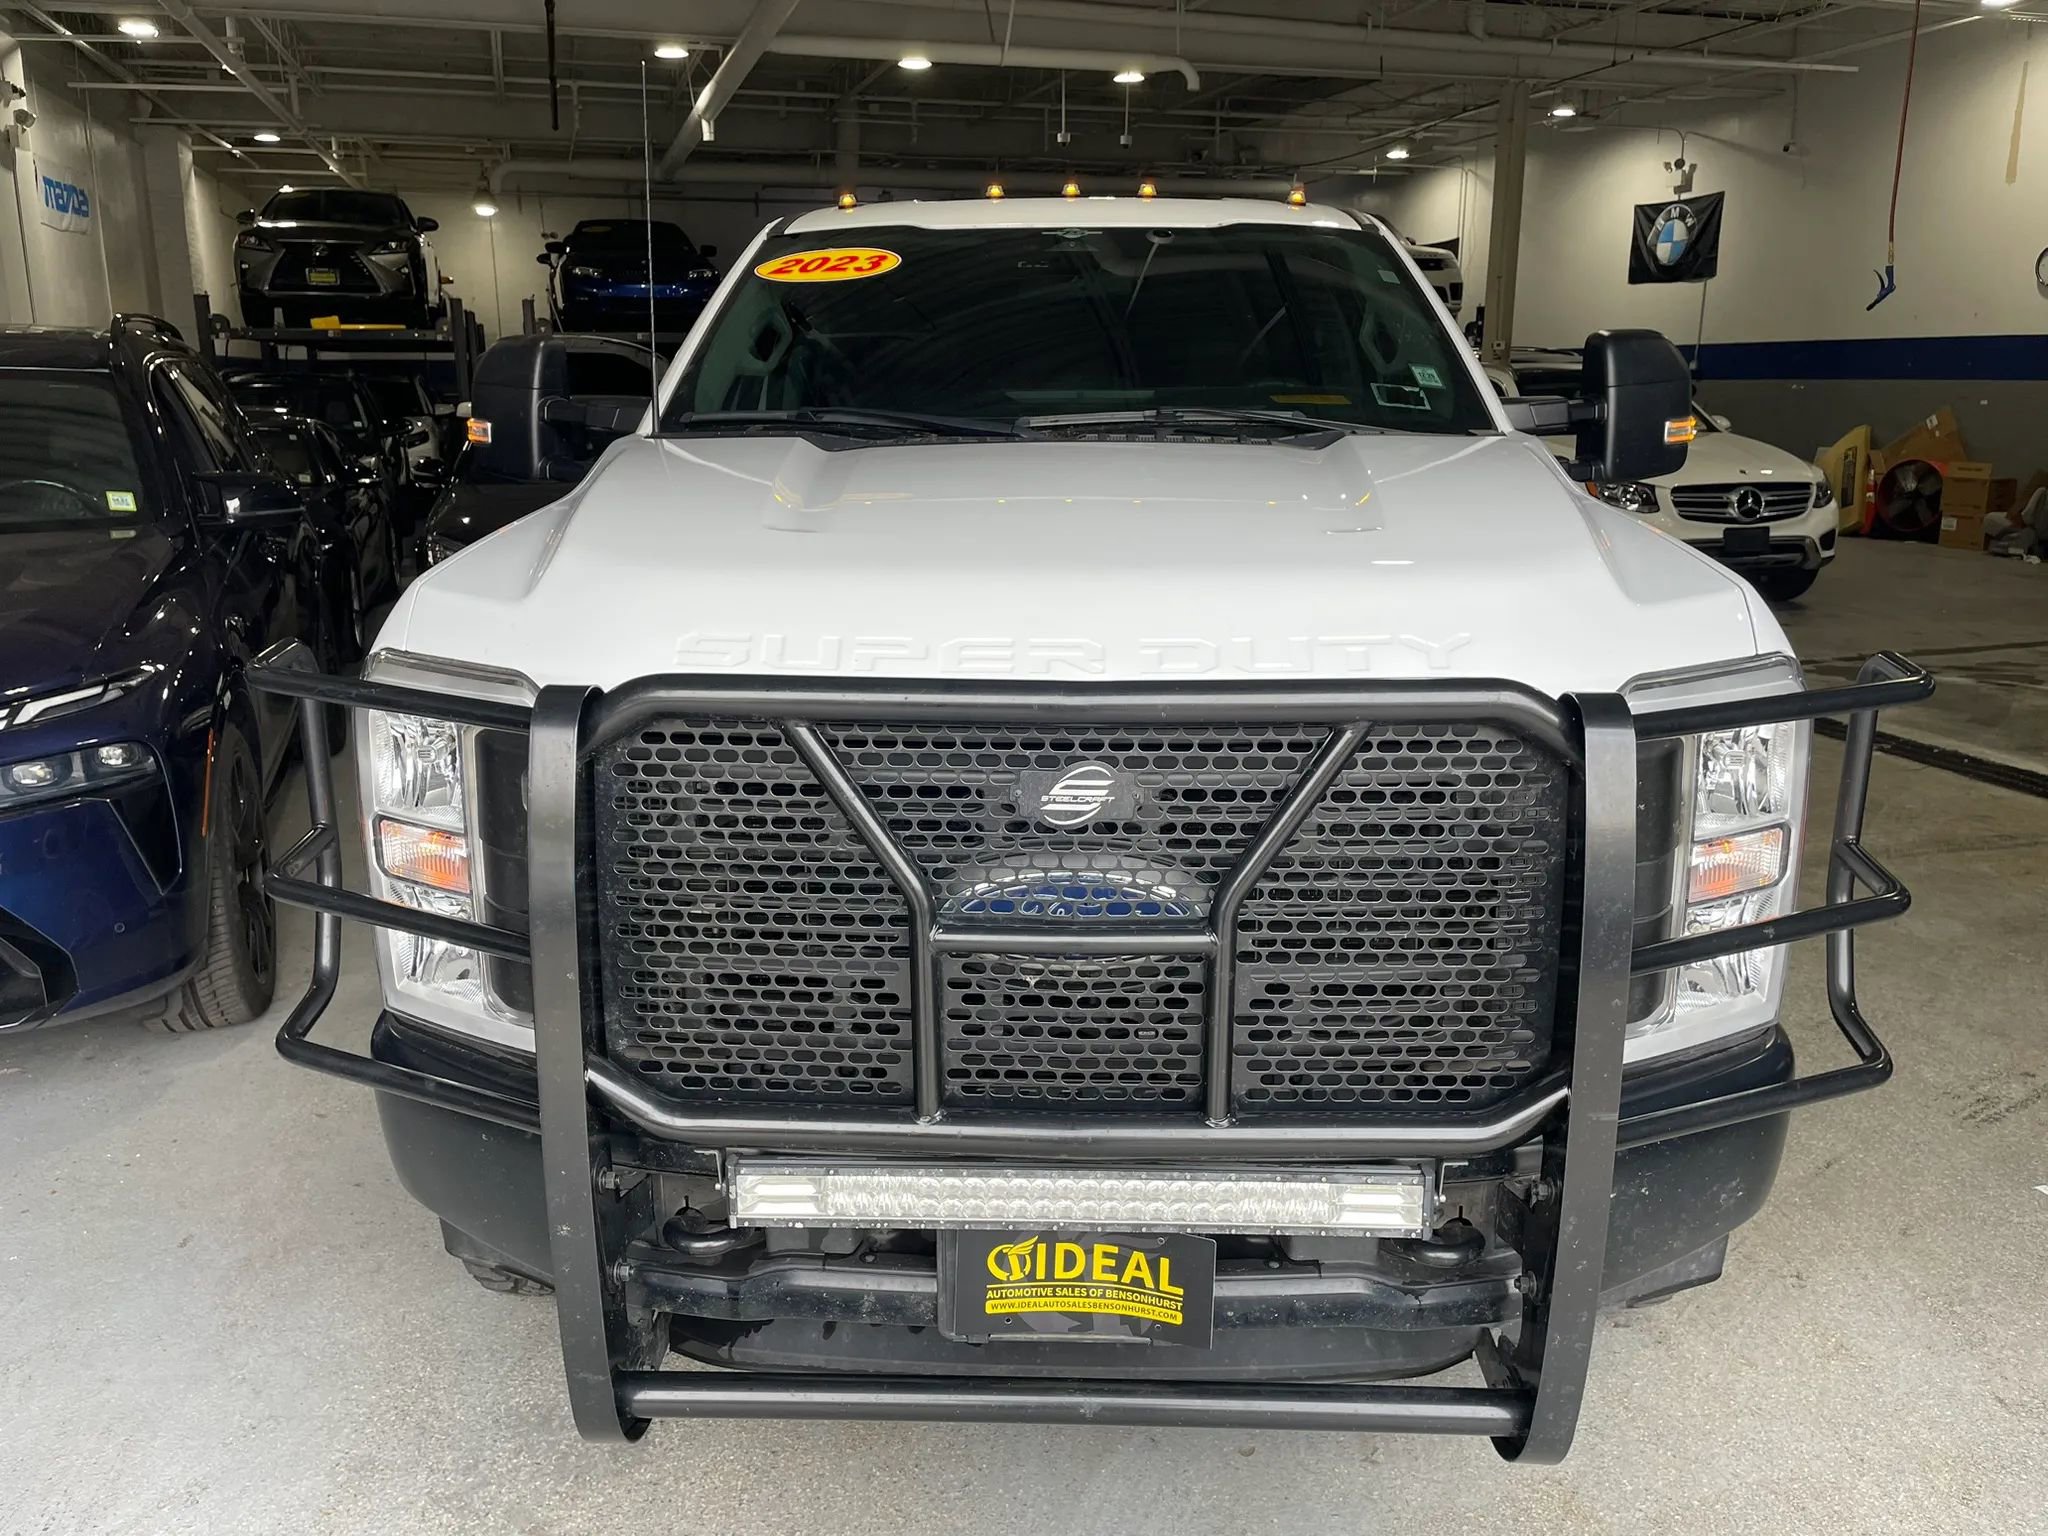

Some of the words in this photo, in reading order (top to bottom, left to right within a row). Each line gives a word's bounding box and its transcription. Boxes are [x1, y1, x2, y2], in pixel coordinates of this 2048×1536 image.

[767, 254, 889, 276] 2023
[673, 631, 1106, 674] SUPER
[1138, 632, 1472, 674] DUTY
[1040, 795, 1116, 804] STEELCRAFT
[1035, 1242, 1184, 1297] IDEAL
[986, 1287, 1054, 1299] AUTOMOTIVE
[1055, 1287, 1087, 1297] SALES
[1089, 1288, 1104, 1298] OF
[1105, 1289, 1184, 1311] BENSONHURST
[990, 1300, 1179, 1321] WWW.IDEALAUTOSALESBENSONHURST.COM
